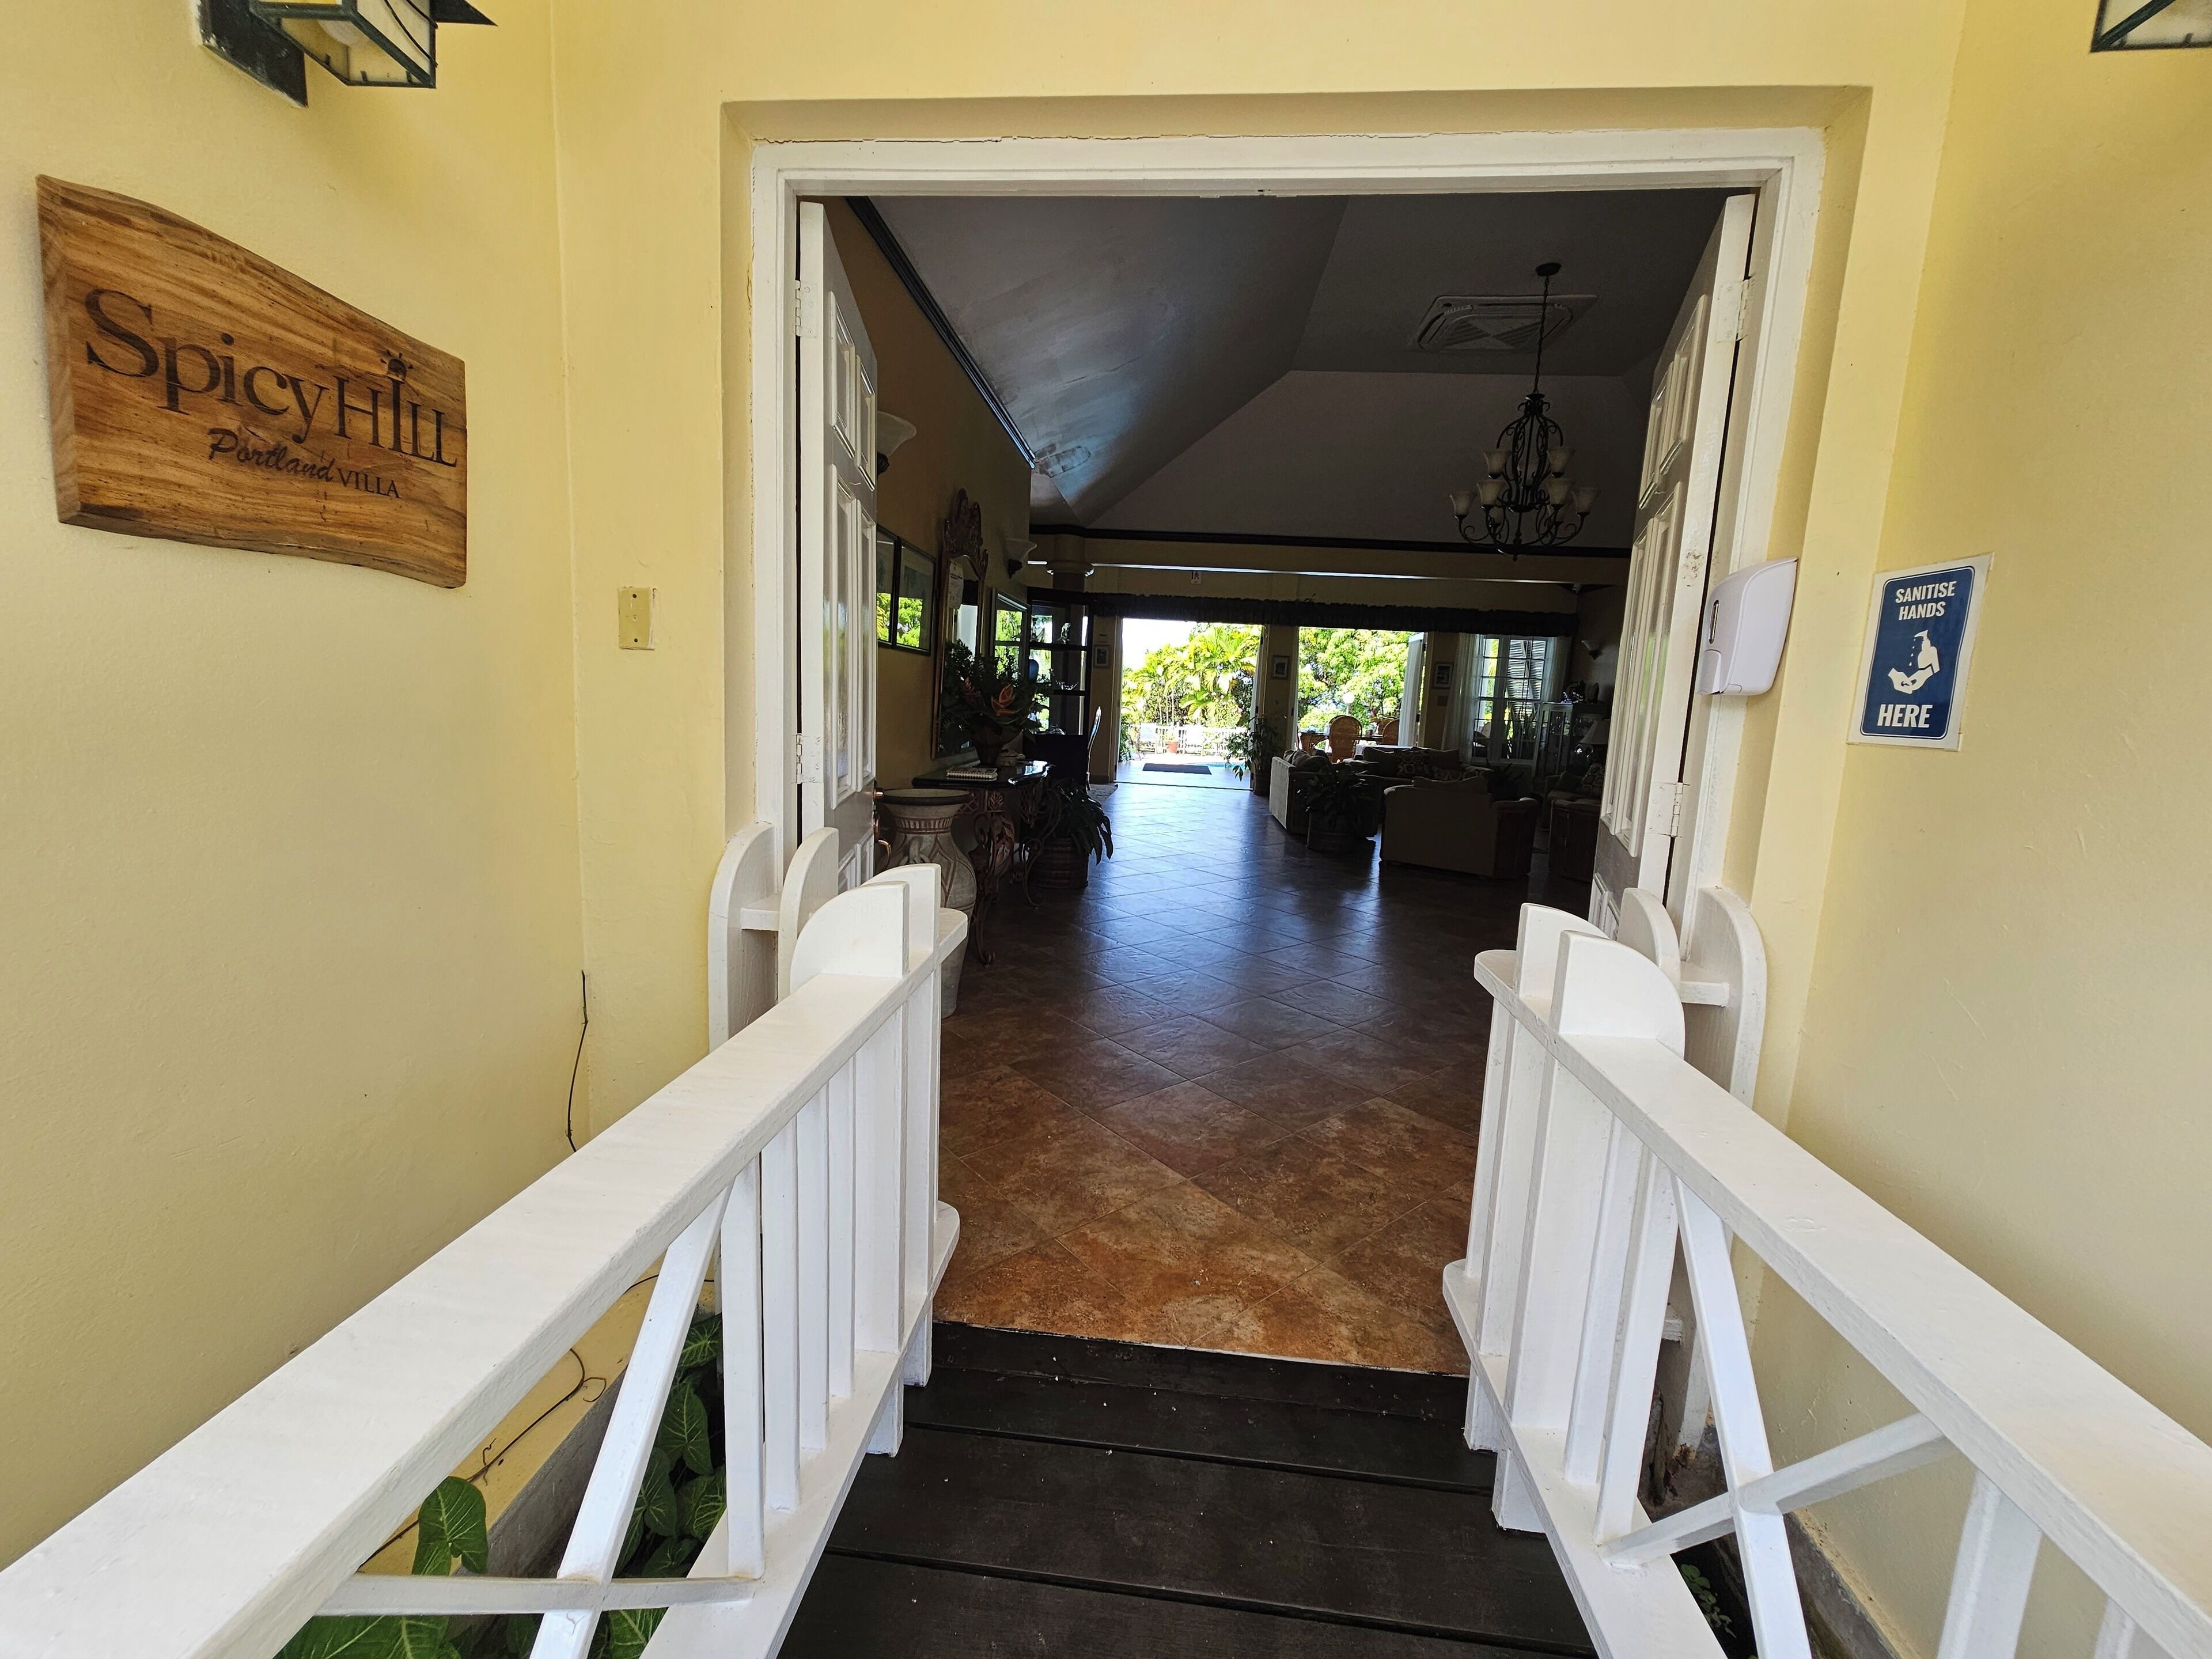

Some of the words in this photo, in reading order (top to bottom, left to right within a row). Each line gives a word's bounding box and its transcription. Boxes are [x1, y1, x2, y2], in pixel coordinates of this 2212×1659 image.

[207, 427, 334, 482] Portland
[338, 467, 402, 499] VILLA
[1895, 581, 1957, 604] SANITISE
[1898, 601, 1946, 621] HANDS
[1877, 704, 1933, 729] HERE
